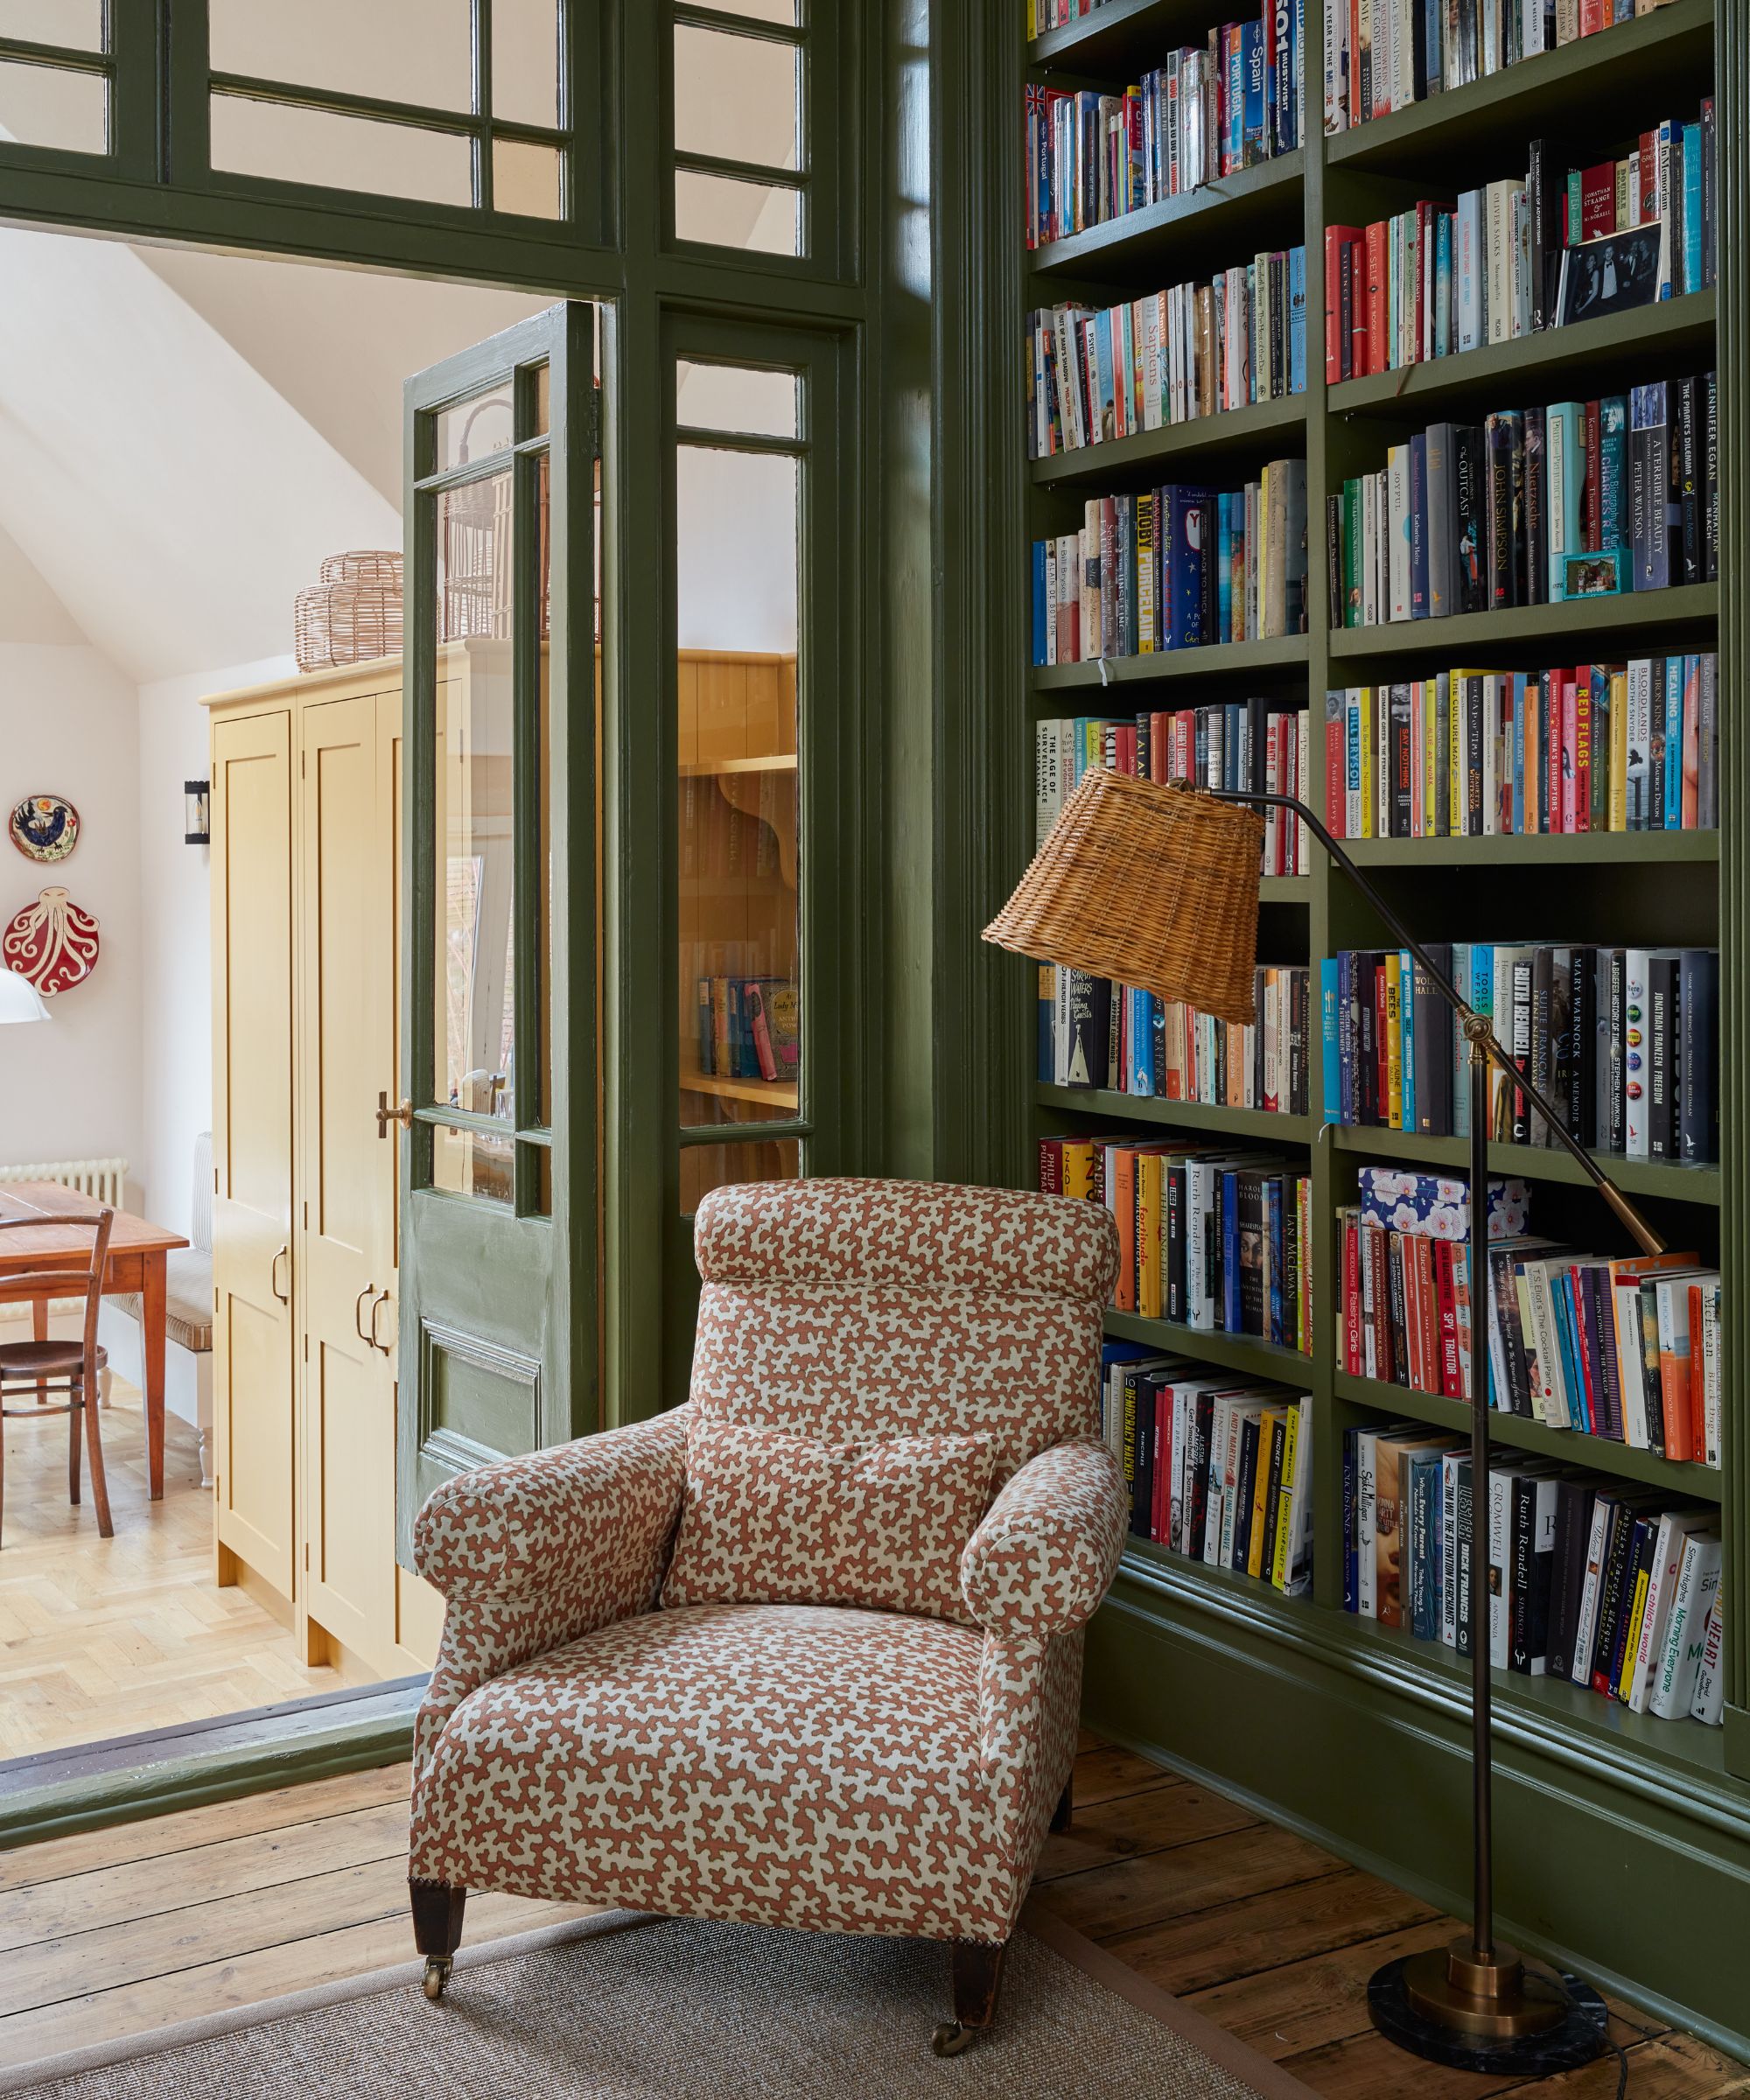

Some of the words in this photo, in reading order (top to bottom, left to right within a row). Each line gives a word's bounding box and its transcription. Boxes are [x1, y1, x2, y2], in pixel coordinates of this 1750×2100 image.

[1231, 54, 1242, 120] PORTUGAL
[1250, 47, 1264, 92] Spain
[1585, 186, 1611, 200] JONATHAN
[1585, 193, 1610, 207] STRANGE
[1145, 326, 1158, 386] Sapiens
[1460, 461, 1469, 518] OUTCAST
[1494, 464, 1505, 503] JOHN
[1530, 463, 1540, 528] Nietzsche
[1139, 501, 1152, 549] MOBY
[1496, 508, 1507, 570] SIMPSON
[1050, 591, 1055, 599] DE
[1059, 568, 1068, 599] Bryson
[1138, 553, 1152, 640] PORCELAIN
[1578, 690, 1588, 716] RED
[1669, 666, 1678, 718] HEALING
[1654, 705, 1662, 728] KING
[1349, 738, 1359, 788] BRYSON
[1578, 724, 1588, 766] FLAGS
[1050, 782, 1055, 794] OF
[1330, 801, 1339, 820] Levy
[1501, 961, 1509, 990] Howard
[1515, 967, 1530, 1002] RUTH
[1573, 997, 1582, 1058] WARNOCK
[1655, 992, 1663, 1031] JONATHAN
[1515, 1005, 1530, 1056] RENDELL
[1654, 1033, 1663, 1066] FRANZEN
[1654, 1071, 1662, 1104] FREEDOM
[1140, 1208, 1149, 1266] fortitude
[1193, 1207, 1201, 1254] Rendell
[1419, 1244, 1429, 1284] Educated
[1348, 1292, 1358, 1326] Raising
[1534, 1284, 1544, 1310] Eliot's
[1443, 1313, 1454, 1329] SPY
[1350, 1329, 1359, 1352] Girls
[1446, 1339, 1457, 1375] TRAITOR
[1539, 1331, 1550, 1364] Cocktail
[1543, 1367, 1552, 1389] Party'
[1124, 1388, 1138, 1443] DEMOCRACY
[1229, 1412, 1239, 1433] ANDY
[1124, 1445, 1136, 1481] HACKED
[1227, 1436, 1236, 1466] MARTIN
[1360, 1470, 1376, 1491] Spike
[1446, 1485, 1455, 1498] TIM
[1184, 1495, 1194, 1528] Delaney
[1360, 1493, 1376, 1522] Milligan
[1445, 1500, 1454, 1515] WU
[1458, 1485, 1473, 1542] LESTER
[1491, 1483, 1503, 1558] CROMWELL
[1518, 1494, 1530, 1528] Ruth
[1445, 1519, 1454, 1533] THE
[1278, 1527, 1287, 1568] SHRIGLEY
[1445, 1535, 1454, 1578] ATTENTION
[1460, 1543, 1470, 1570] DICK
[1517, 1535, 1529, 1589] Rendell
[1687, 1546, 1697, 1572] Simon
[1445, 1578, 1455, 1626] MERCHANTS
[1460, 1572, 1470, 1623] FRANCIS
[1676, 1573, 1692, 1604] Hughes
[1644, 1592, 1656, 1629] child's
[1670, 1607, 1688, 1648] Morning
[1639, 1633, 1648, 1664] world
[1704, 1620, 1721, 1670] HEART
[1661, 1648, 1679, 1696] Everyone
